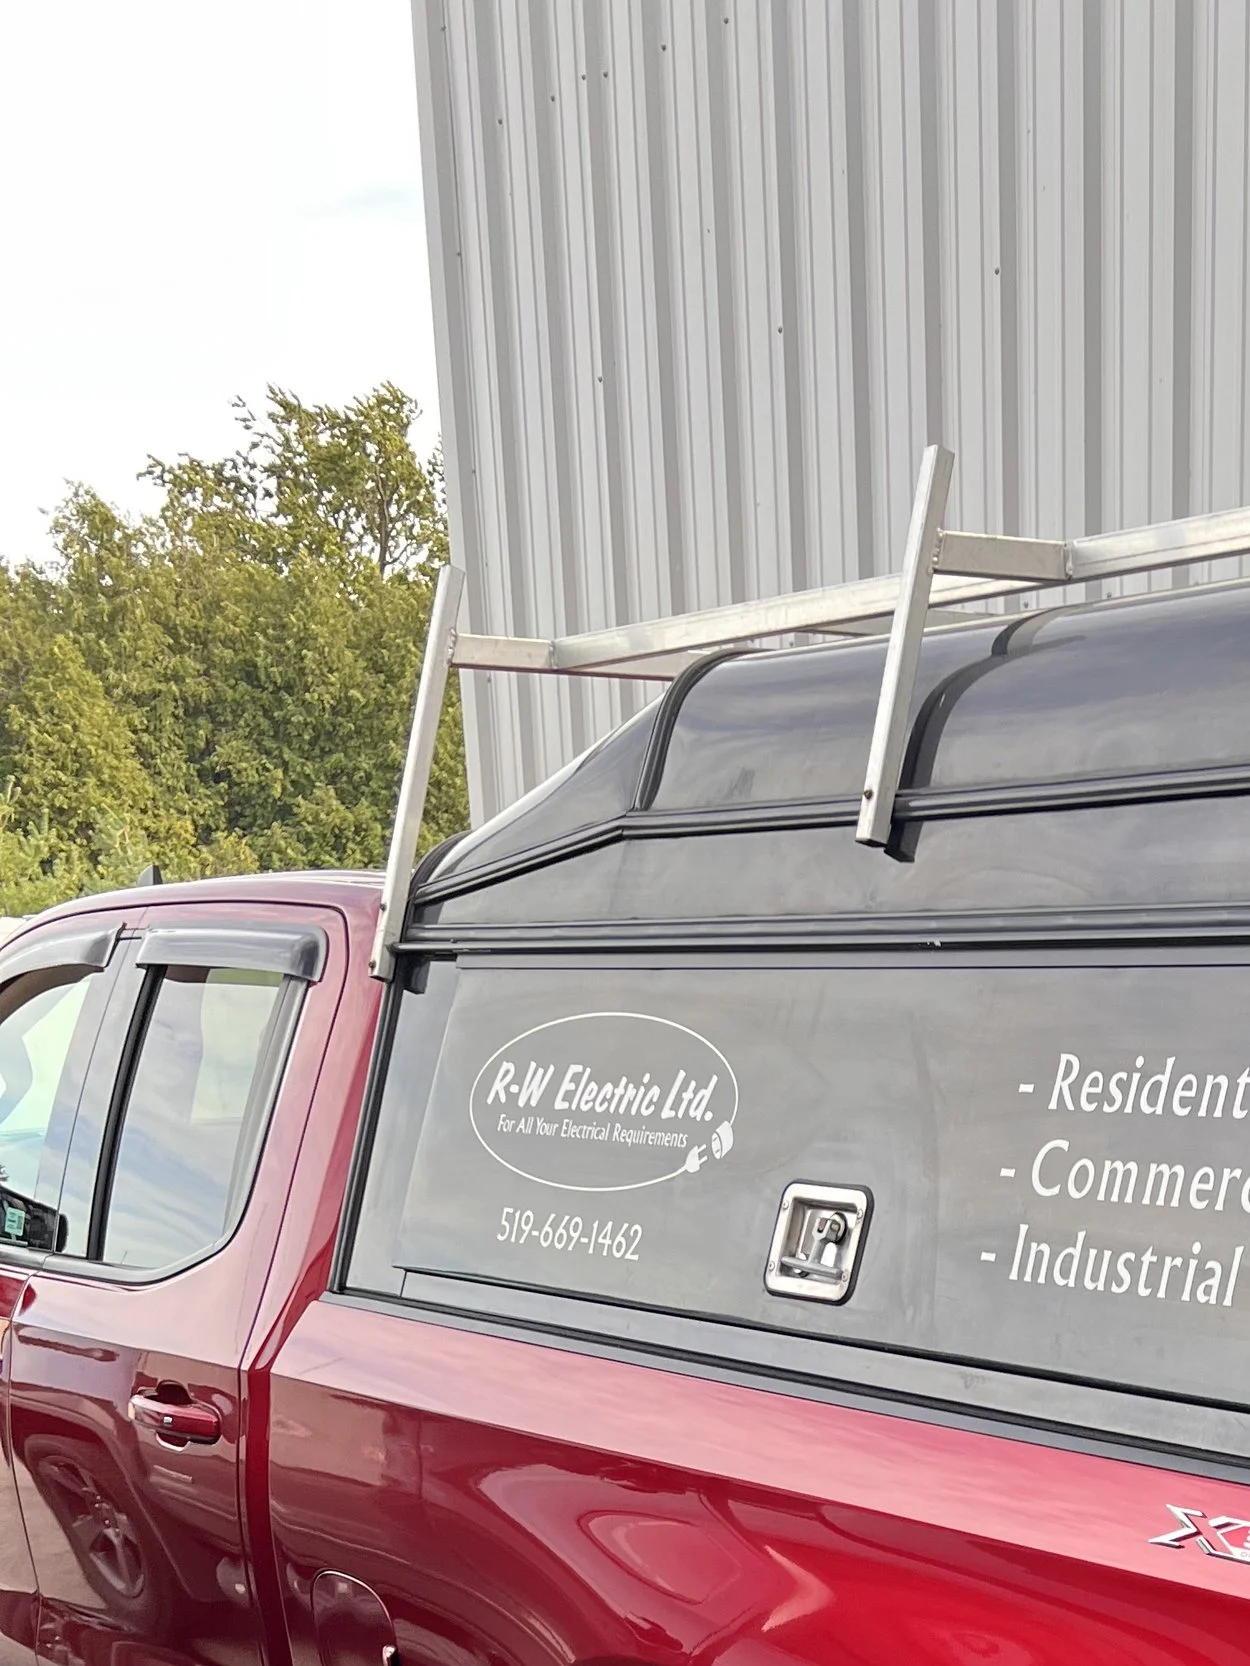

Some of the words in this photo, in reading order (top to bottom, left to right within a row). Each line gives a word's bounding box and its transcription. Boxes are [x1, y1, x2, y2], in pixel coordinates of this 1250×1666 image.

[487, 1061, 555, 1108] R-W
[554, 1064, 660, 1116] Electric
[660, 1069, 718, 1121] Ltd.
[497, 1113, 516, 1132] For
[518, 1116, 534, 1134] All
[535, 1116, 559, 1137] Your
[560, 1118, 611, 1141] Electrical
[612, 1123, 688, 1148] Requirements
[496, 1206, 643, 1262] 519-669-1462
[1008, 1223, 1245, 1307] Industrial
